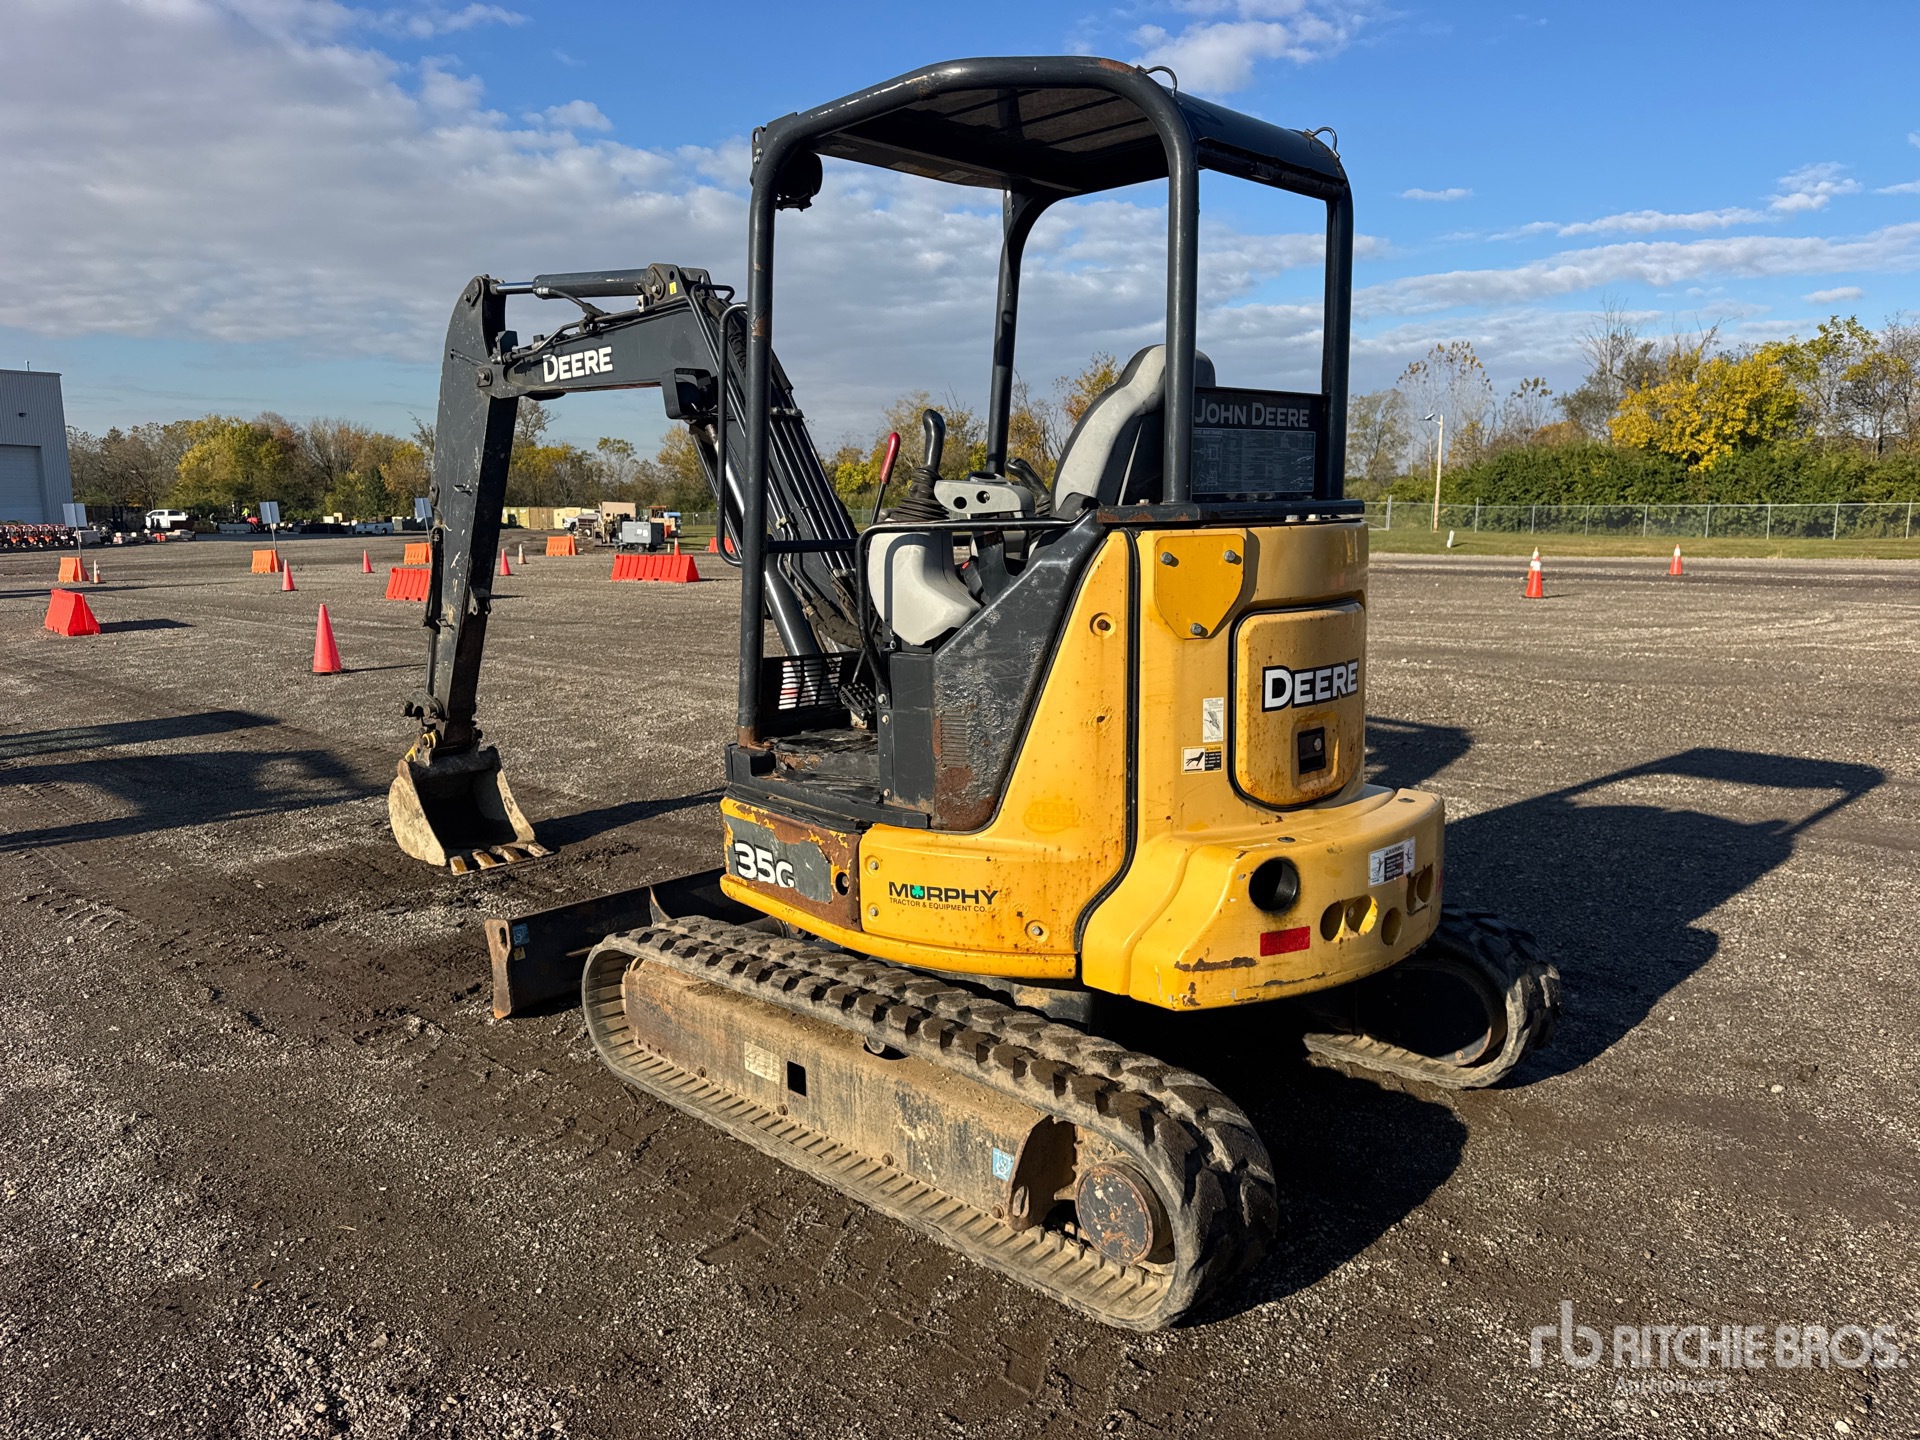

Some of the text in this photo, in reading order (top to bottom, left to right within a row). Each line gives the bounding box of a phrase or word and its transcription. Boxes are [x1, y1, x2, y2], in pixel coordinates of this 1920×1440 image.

[542, 346, 614, 383] DEERE
[1194, 399, 1310, 428] JOHN DEERE
[1263, 659, 1359, 711] DEERE
[734, 840, 796, 888] 35G
[888, 881, 999, 905] MURPHY
[889, 897, 921, 908] TRACTOR
[929, 902, 971, 912] EQUIPMENT
[973, 905, 988, 913] CO.
